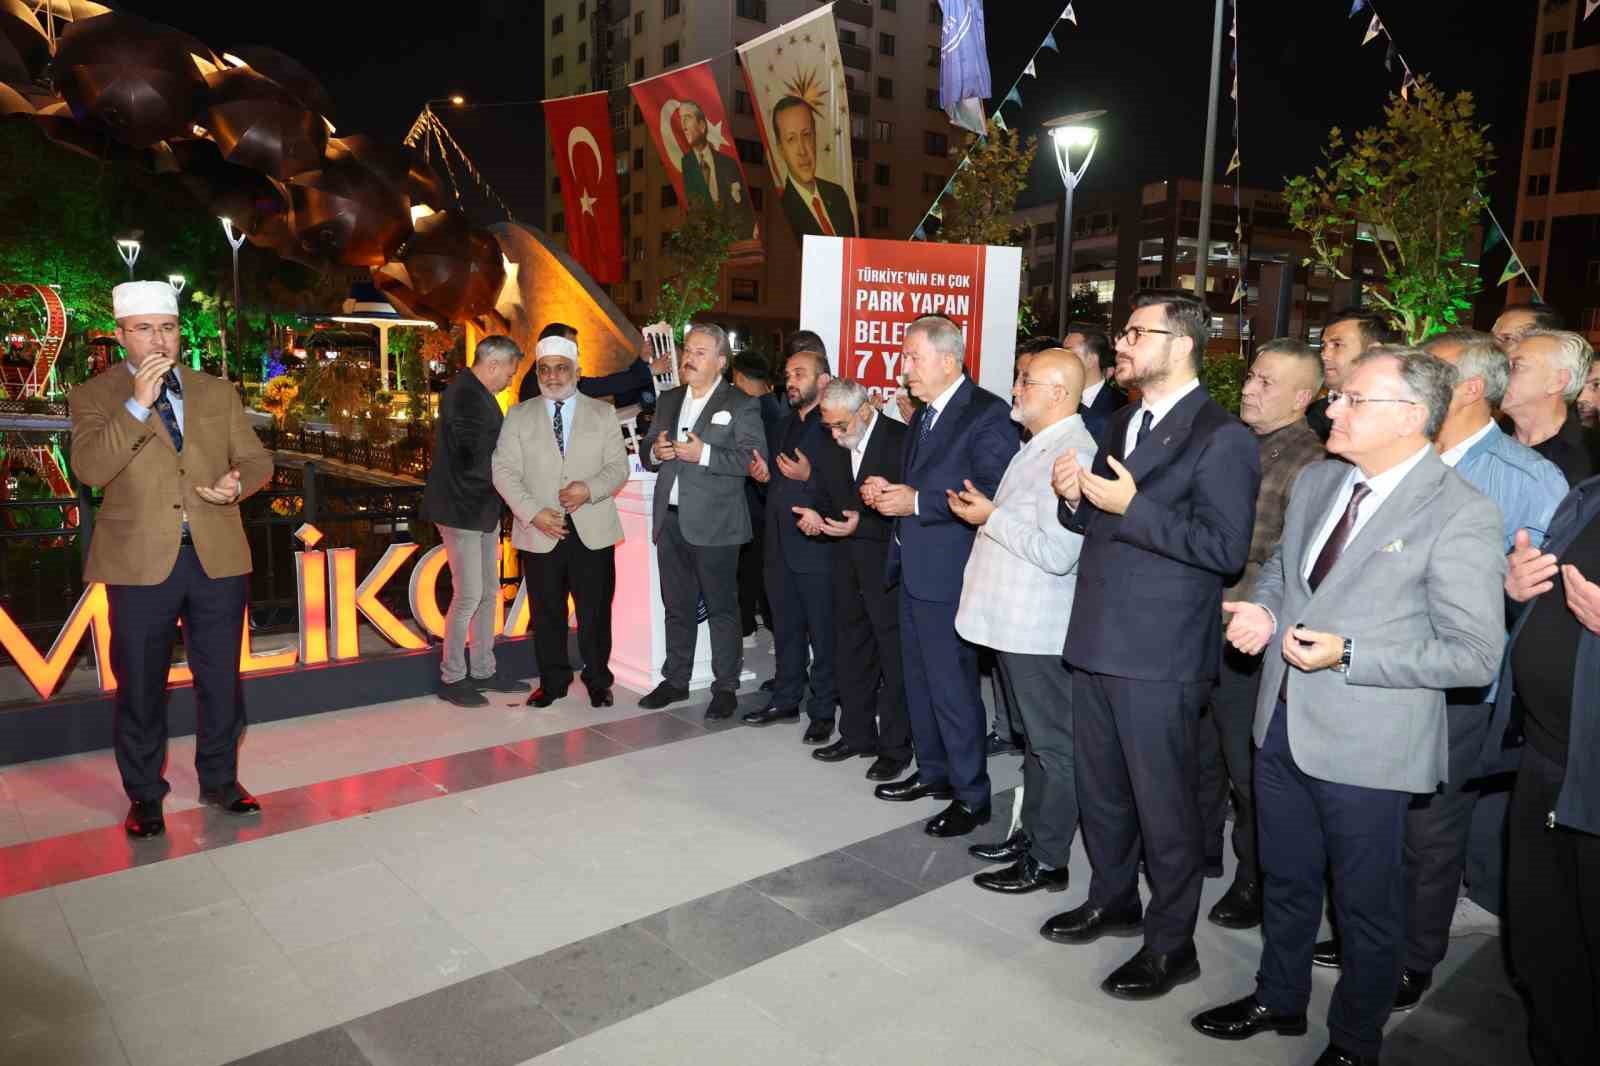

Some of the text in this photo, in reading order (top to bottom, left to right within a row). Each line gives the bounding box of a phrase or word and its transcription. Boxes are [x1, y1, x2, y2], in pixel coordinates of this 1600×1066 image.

[857, 268, 970, 289] TÜRKİYE'NİN EN ÇOK
[856, 289, 969, 315] PARK YAPAN
[855, 350, 873, 379] 7
